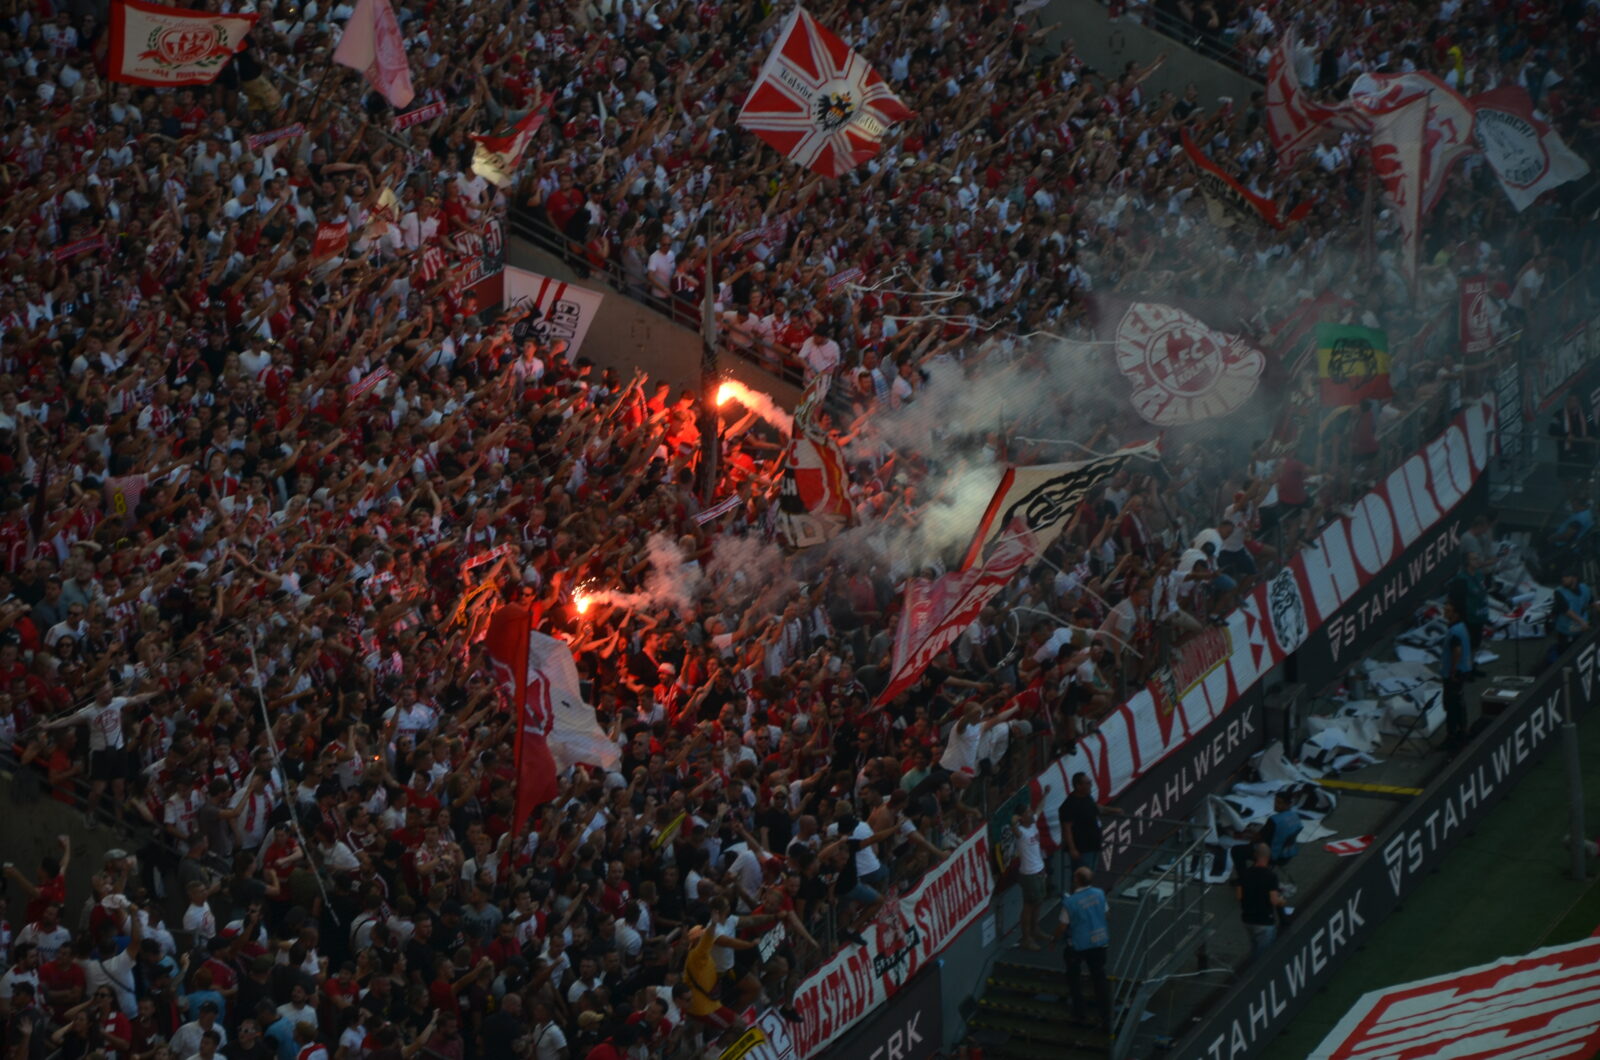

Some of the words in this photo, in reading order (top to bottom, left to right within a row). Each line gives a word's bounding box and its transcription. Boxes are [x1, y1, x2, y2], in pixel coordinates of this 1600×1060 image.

[113, 491, 126, 516] 8
[1343, 520, 1461, 646] STAHLWERK
[1117, 704, 1256, 855] STAHLWERK
[1407, 688, 1563, 874] STAHLWERK
[1198, 887, 1366, 1060] TAHLWERK
